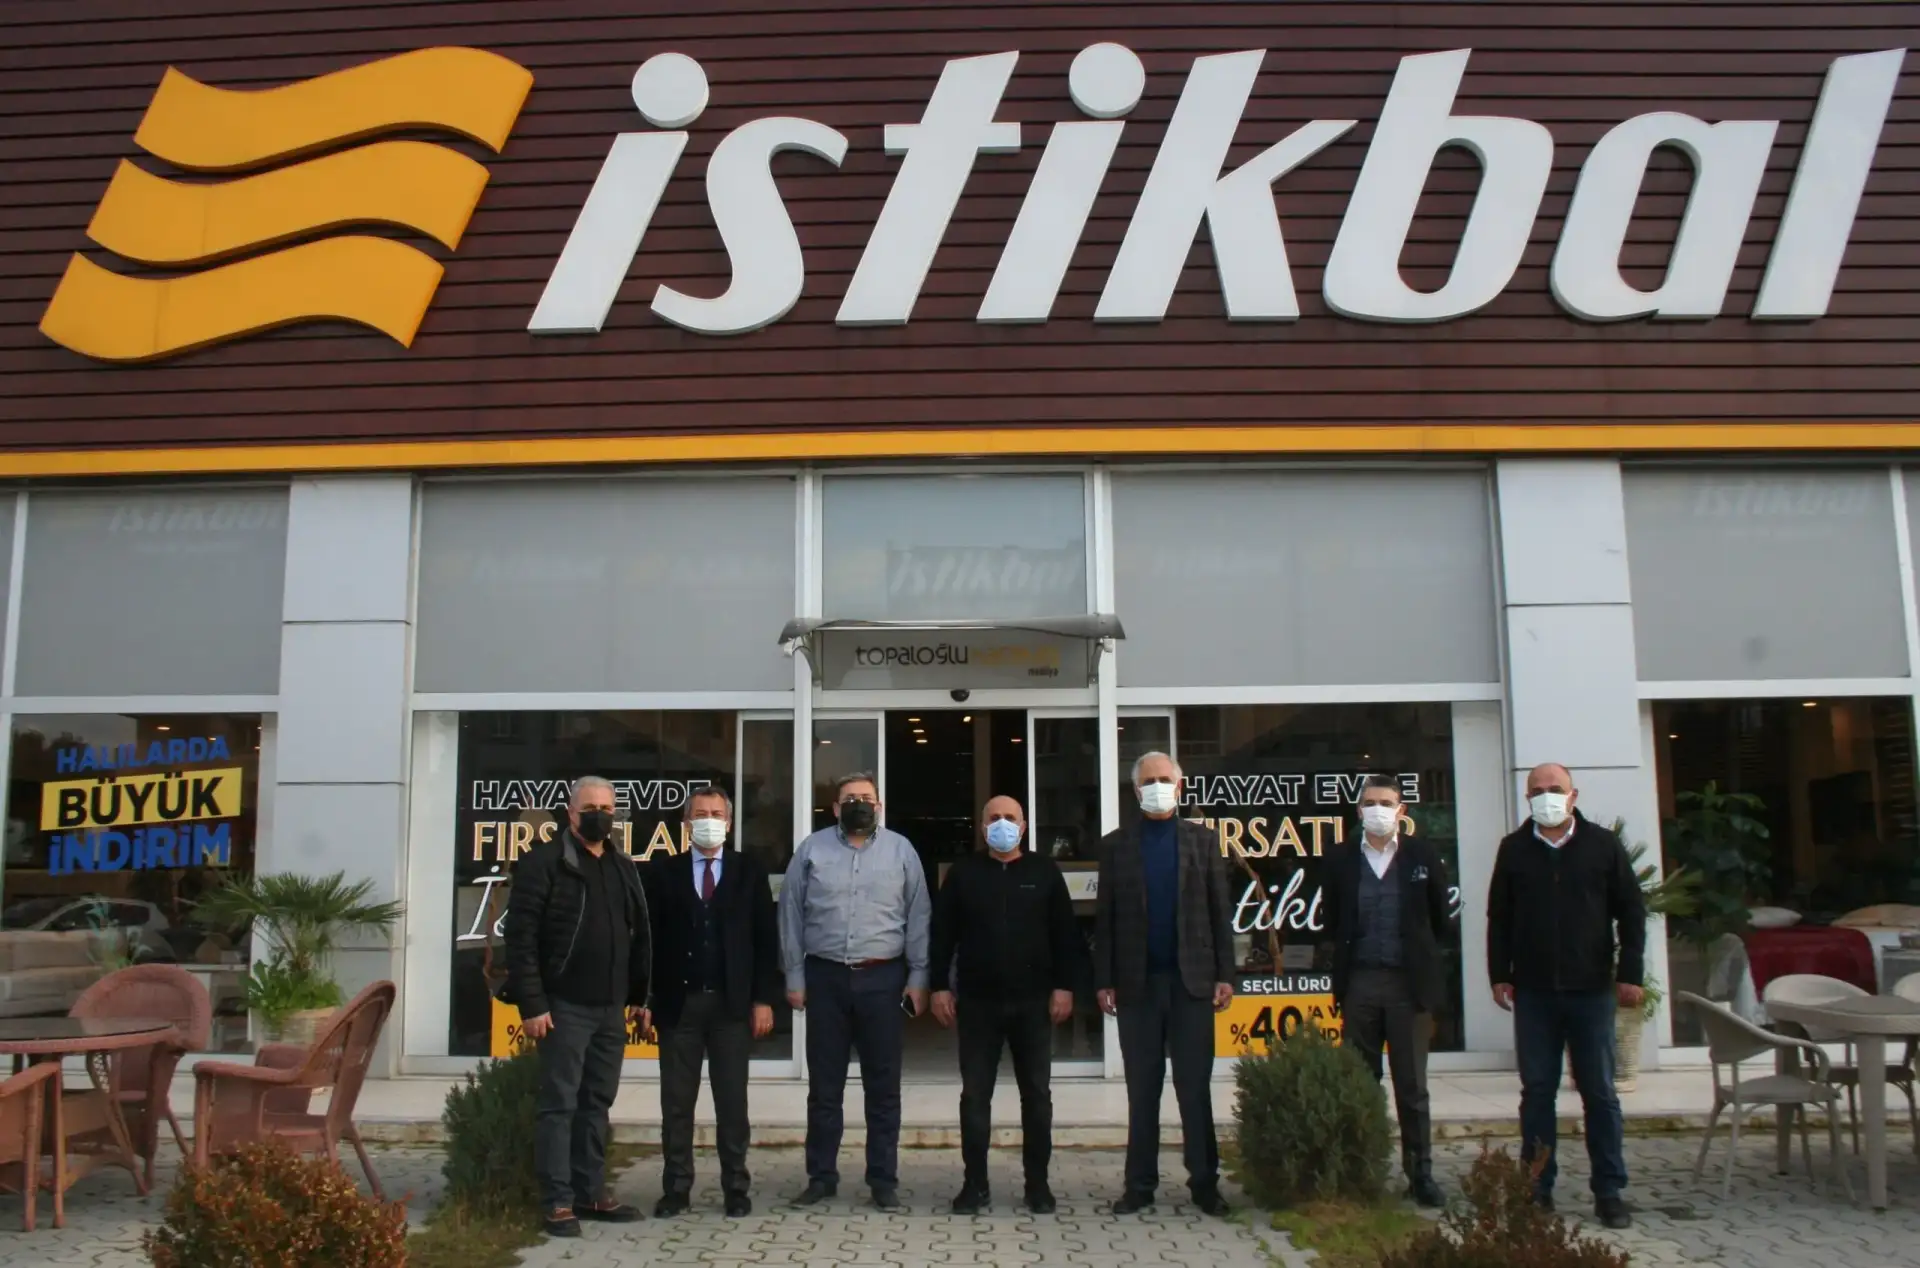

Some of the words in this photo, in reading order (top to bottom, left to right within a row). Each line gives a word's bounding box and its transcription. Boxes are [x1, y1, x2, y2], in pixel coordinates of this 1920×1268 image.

[527, 42, 1907, 334] istikbal
[855, 643, 969, 666] topaloğlu
[56, 735, 231, 773] HALILARDA
[58, 771, 224, 828] BÜYÜK
[472, 780, 577, 810] HAYA
[1178, 775, 1305, 806] HAYAT
[1315, 773, 1420, 804] EVE
[1242, 976, 1293, 994] SEÇİLİ
[1298, 976, 1333, 991] ÜRÜ
